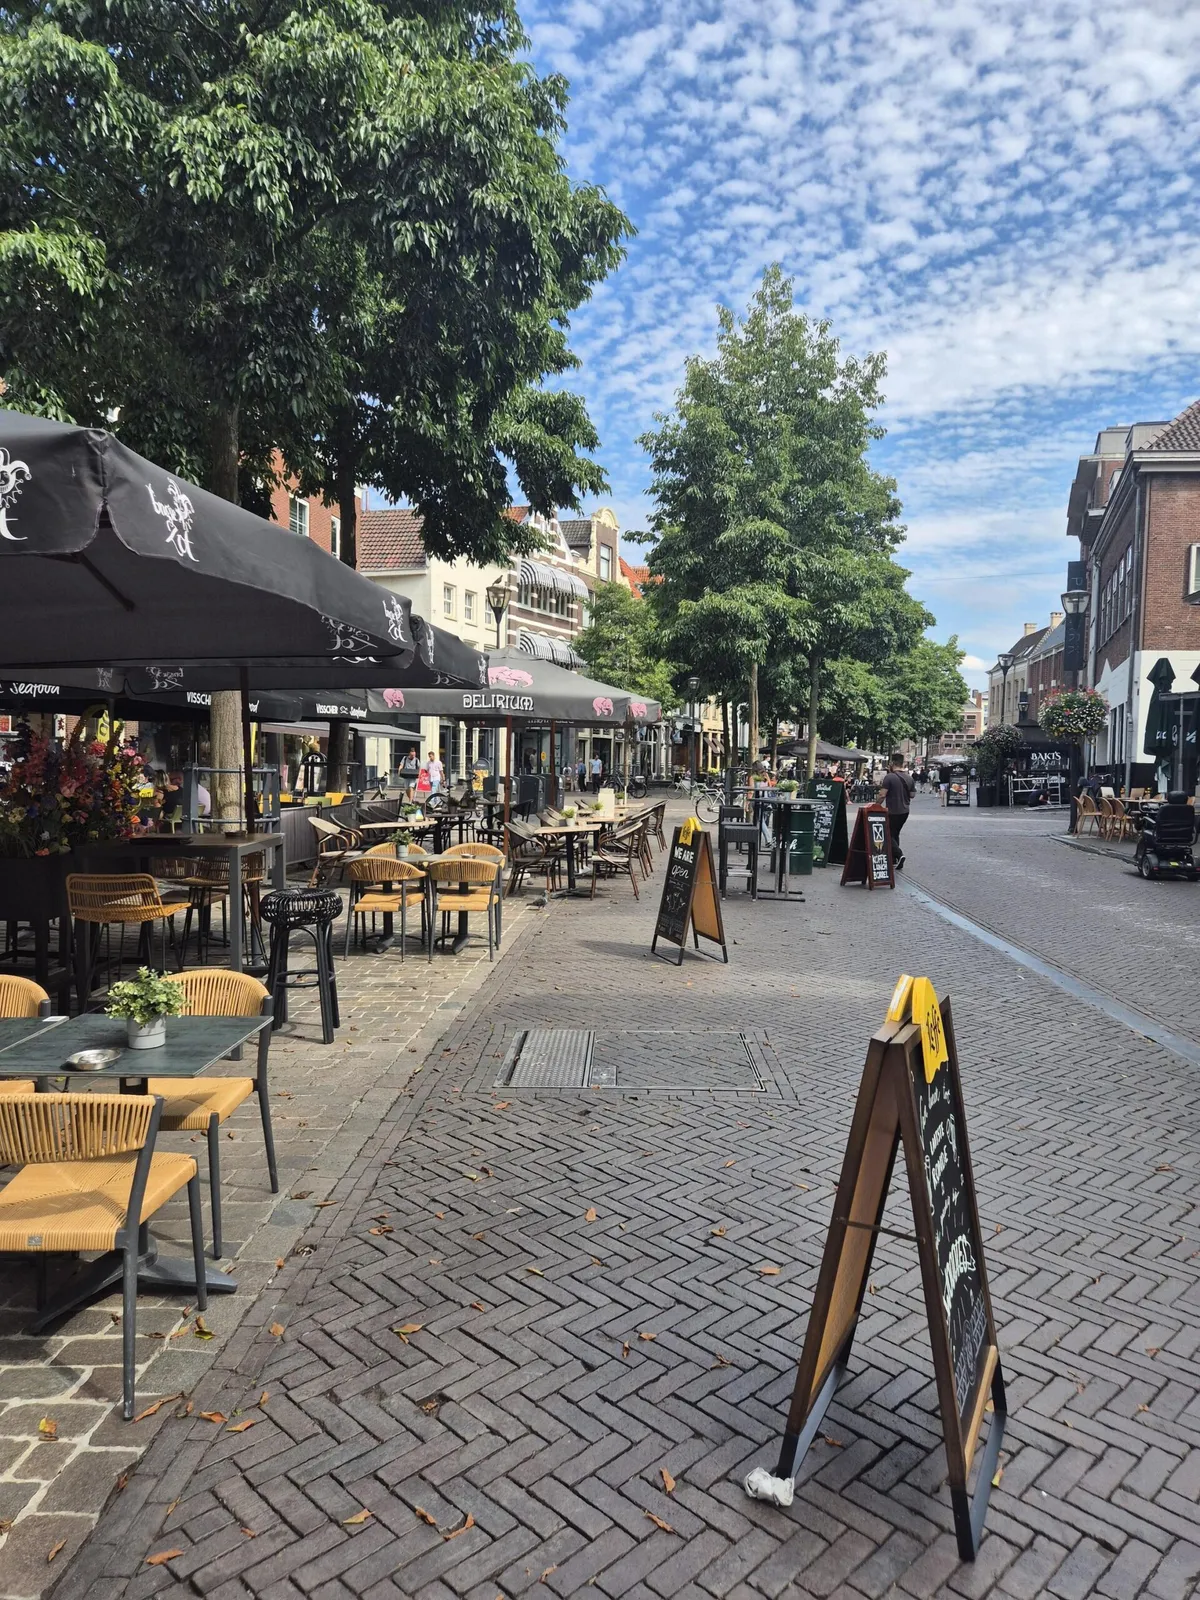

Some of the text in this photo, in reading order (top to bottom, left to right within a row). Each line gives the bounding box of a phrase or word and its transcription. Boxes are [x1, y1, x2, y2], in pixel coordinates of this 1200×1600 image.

[186, 691, 212, 706] VISSCH
[462, 694, 534, 711] DELIRIUM
[315, 703, 339, 715] VISSCHER
[673, 846, 695, 864] WE ARE
